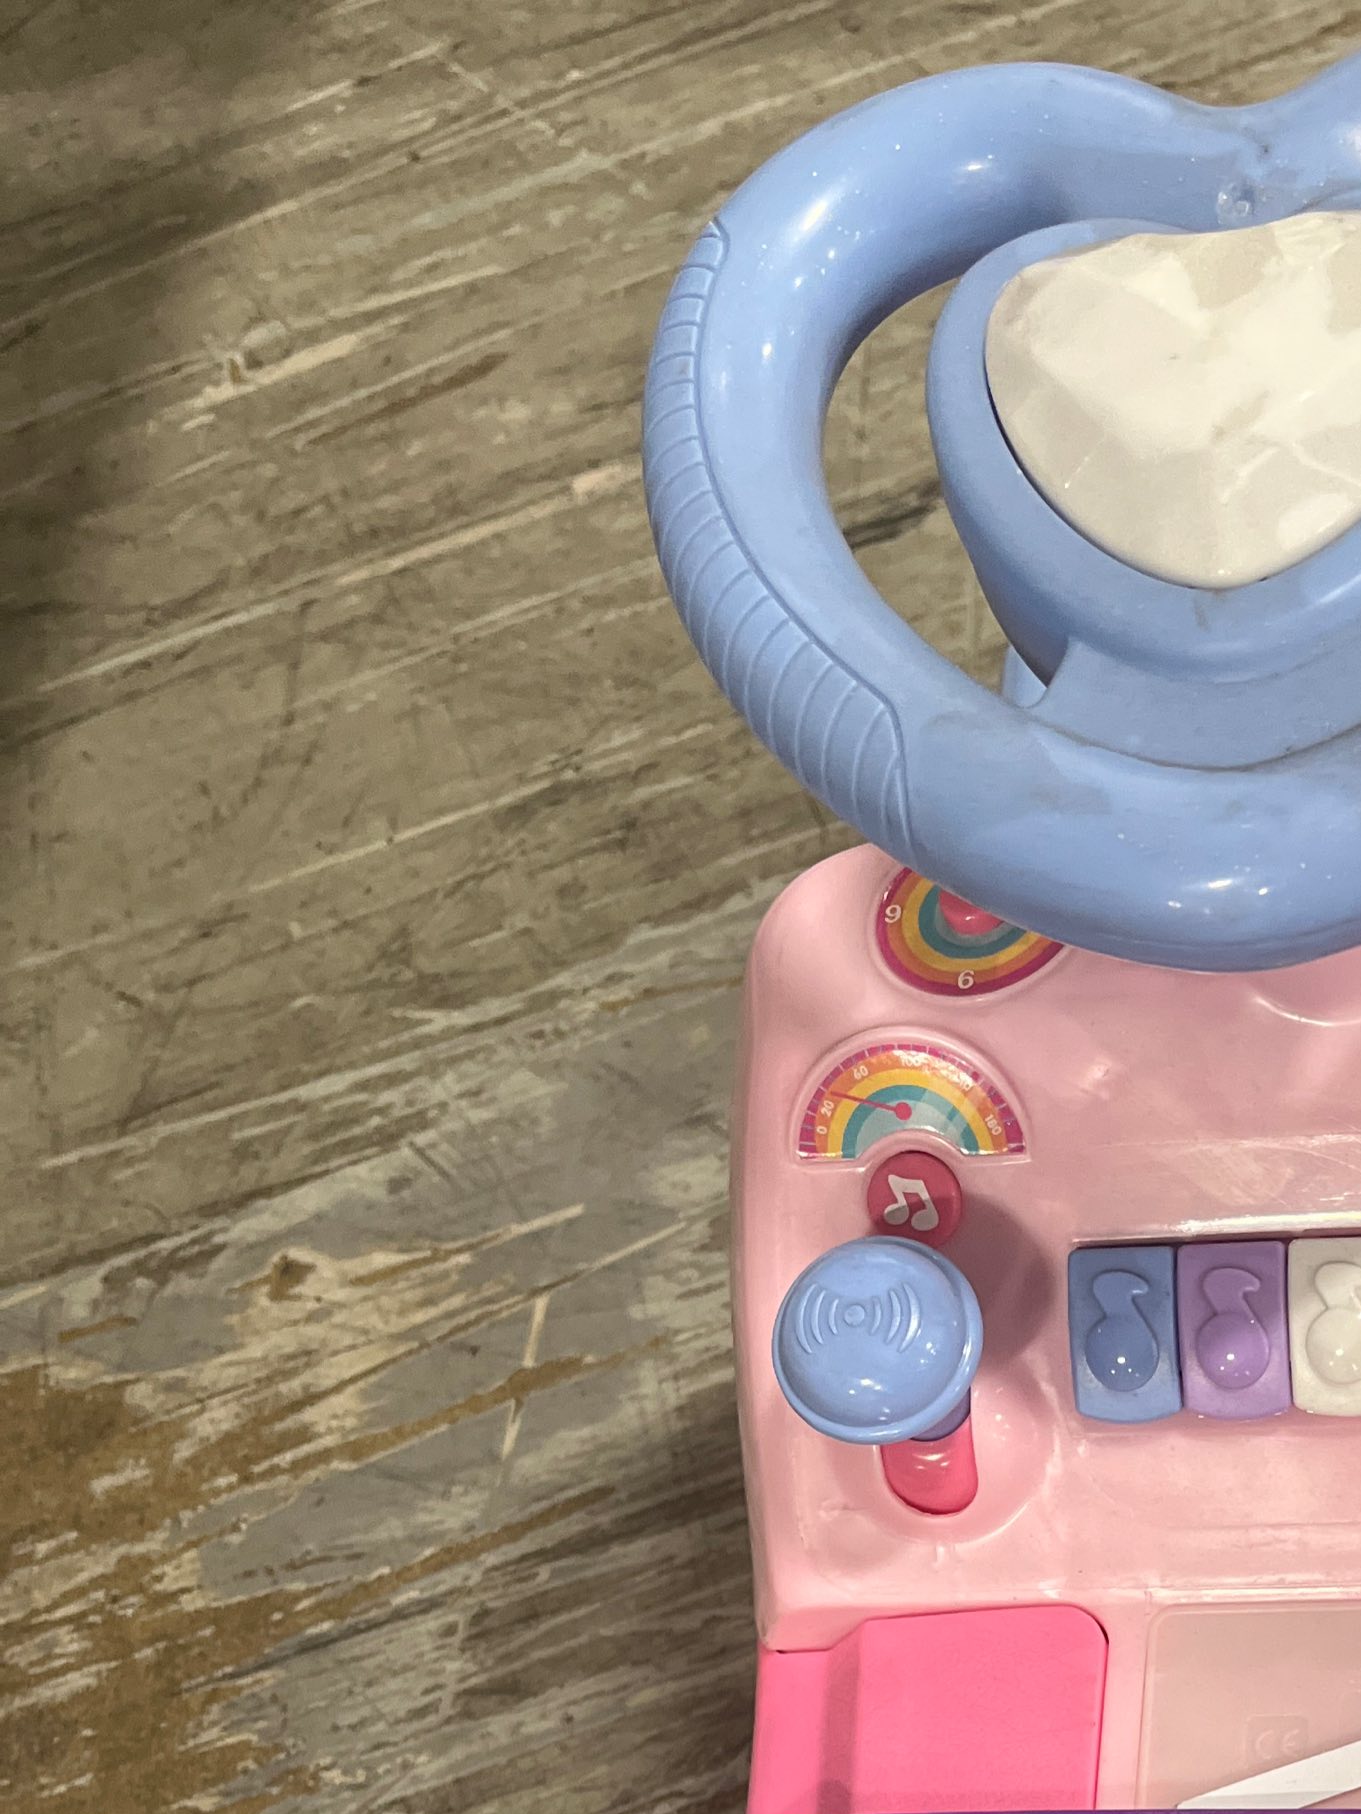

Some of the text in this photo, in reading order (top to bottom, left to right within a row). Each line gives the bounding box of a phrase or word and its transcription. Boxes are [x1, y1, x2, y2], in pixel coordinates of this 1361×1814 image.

[884, 904, 902, 923] 9
[957, 970, 974, 990] 6
[821, 1100, 834, 1118] 20
[853, 1065, 869, 1081] 60
[985, 1113, 1003, 1136] 180
